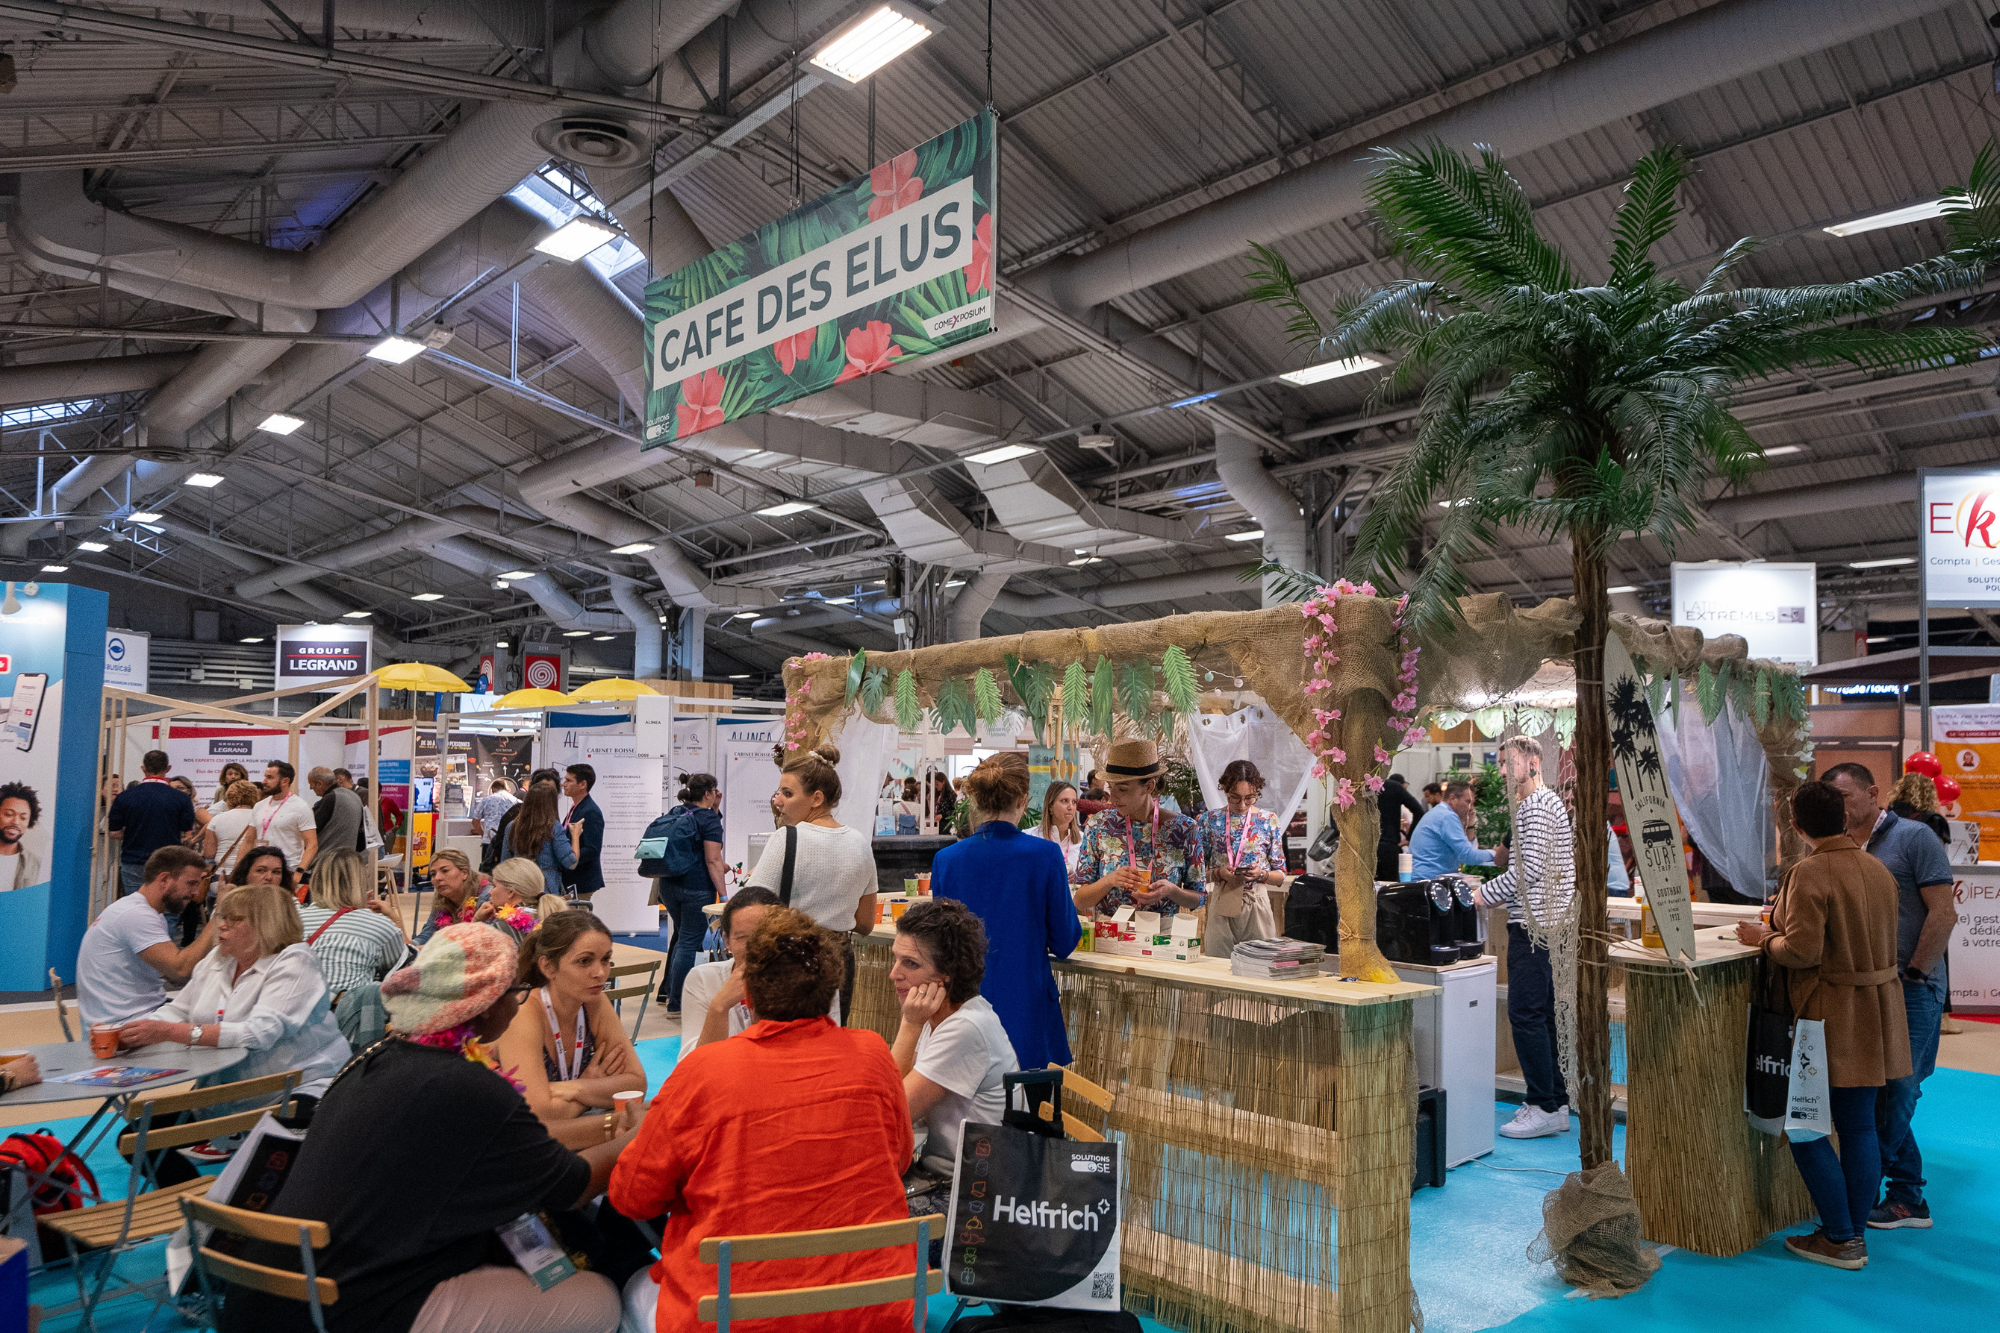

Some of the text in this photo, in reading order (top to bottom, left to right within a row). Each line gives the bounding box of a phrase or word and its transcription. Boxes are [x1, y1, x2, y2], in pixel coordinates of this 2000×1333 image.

[660, 202, 961, 372] CAFE DES ELUS
[1930, 557, 1971, 567] Compta
[289, 659, 358, 671] LEGRAND
[1635, 796, 1666, 811] CALIFORNIA
[1645, 845, 1676, 868] SURF
[1071, 1153, 1110, 1163] SOLUTIONS
[992, 1194, 1099, 1232] Helfrich
